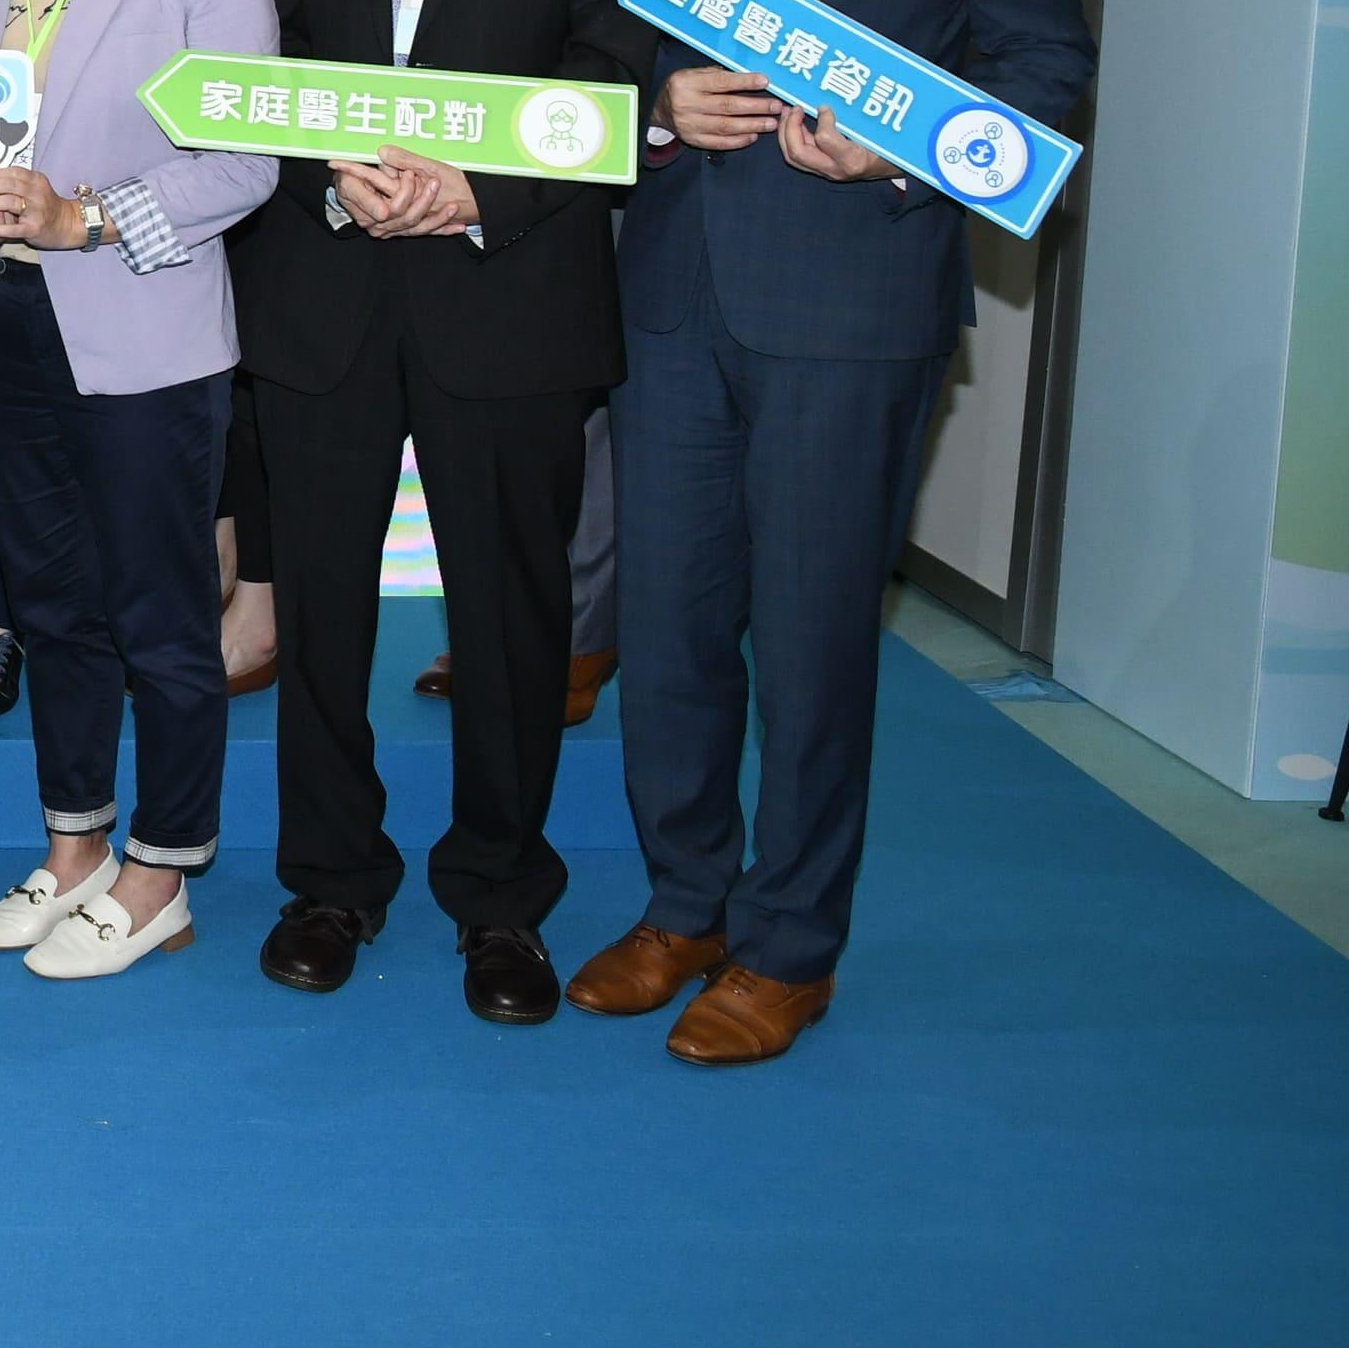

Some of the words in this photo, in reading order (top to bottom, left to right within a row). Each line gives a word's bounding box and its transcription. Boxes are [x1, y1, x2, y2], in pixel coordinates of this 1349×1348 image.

[199, 79, 488, 145] 家庭醫生配對
